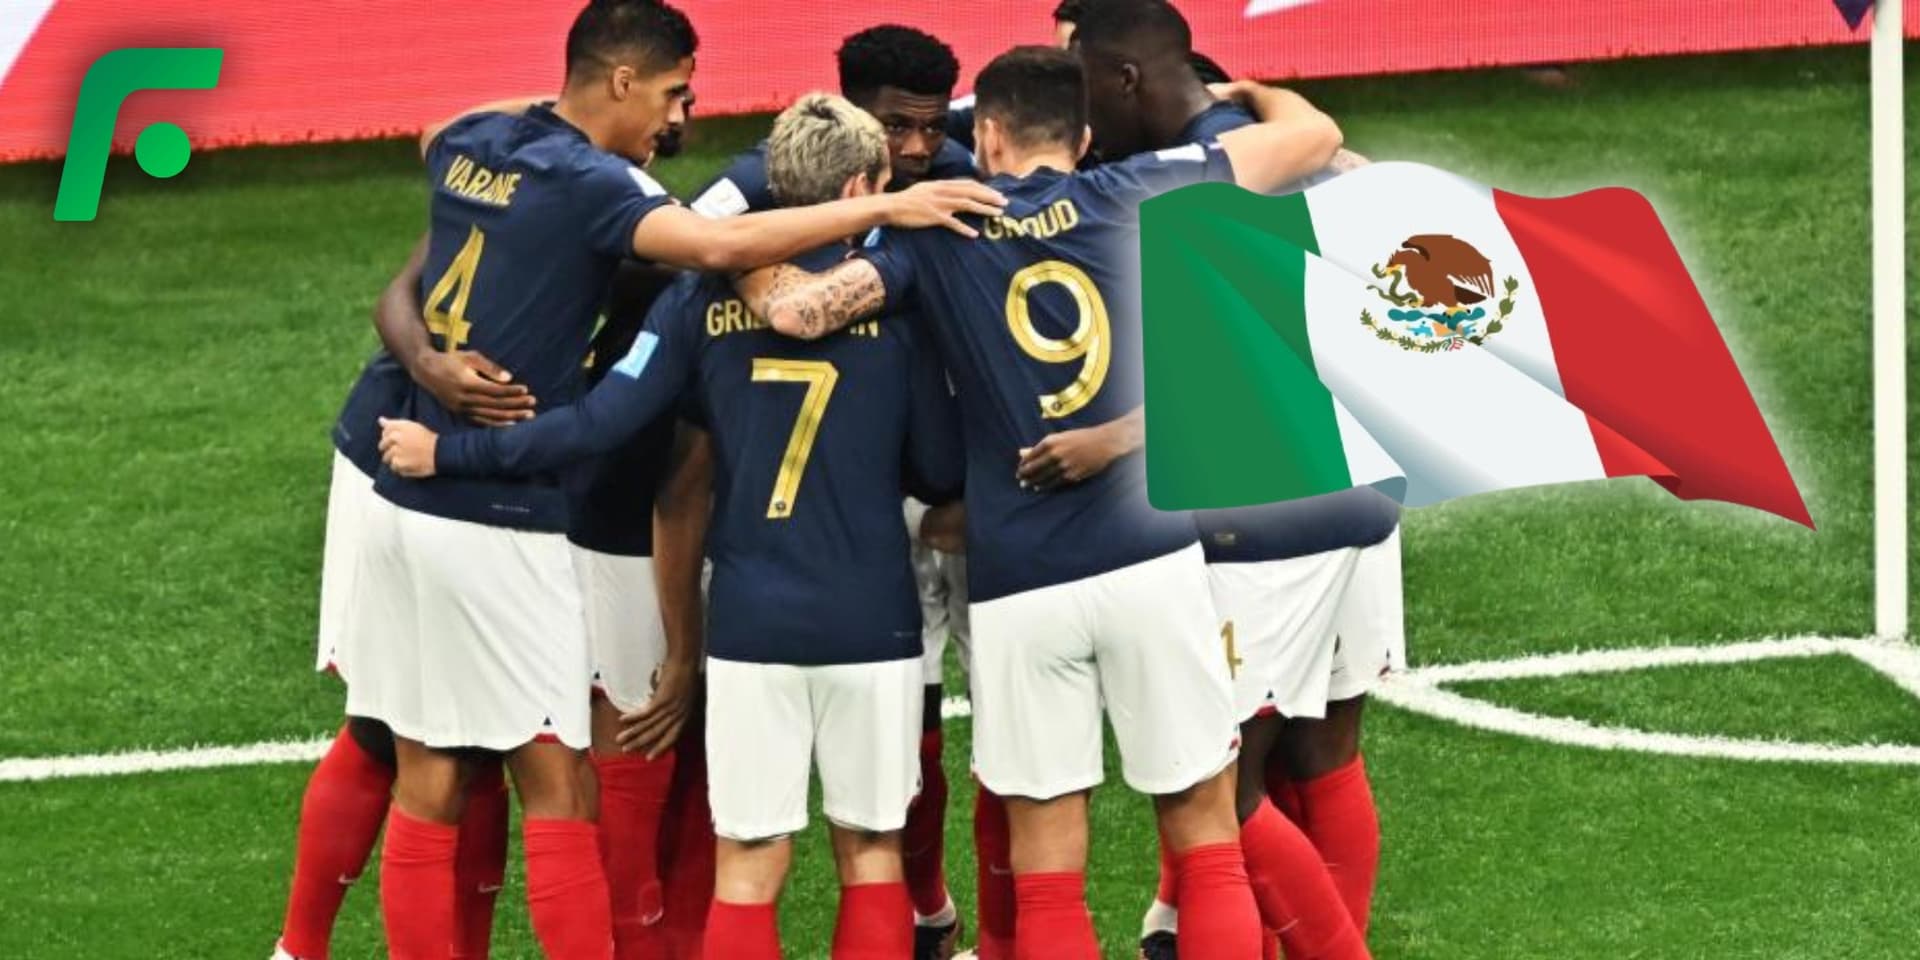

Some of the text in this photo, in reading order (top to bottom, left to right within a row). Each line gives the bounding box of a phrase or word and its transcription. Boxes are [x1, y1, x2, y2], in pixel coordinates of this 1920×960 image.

[444, 154, 522, 207] VARANE
[423, 223, 485, 352] 4
[1005, 259, 1111, 419] 9
[751, 357, 839, 519] 7
